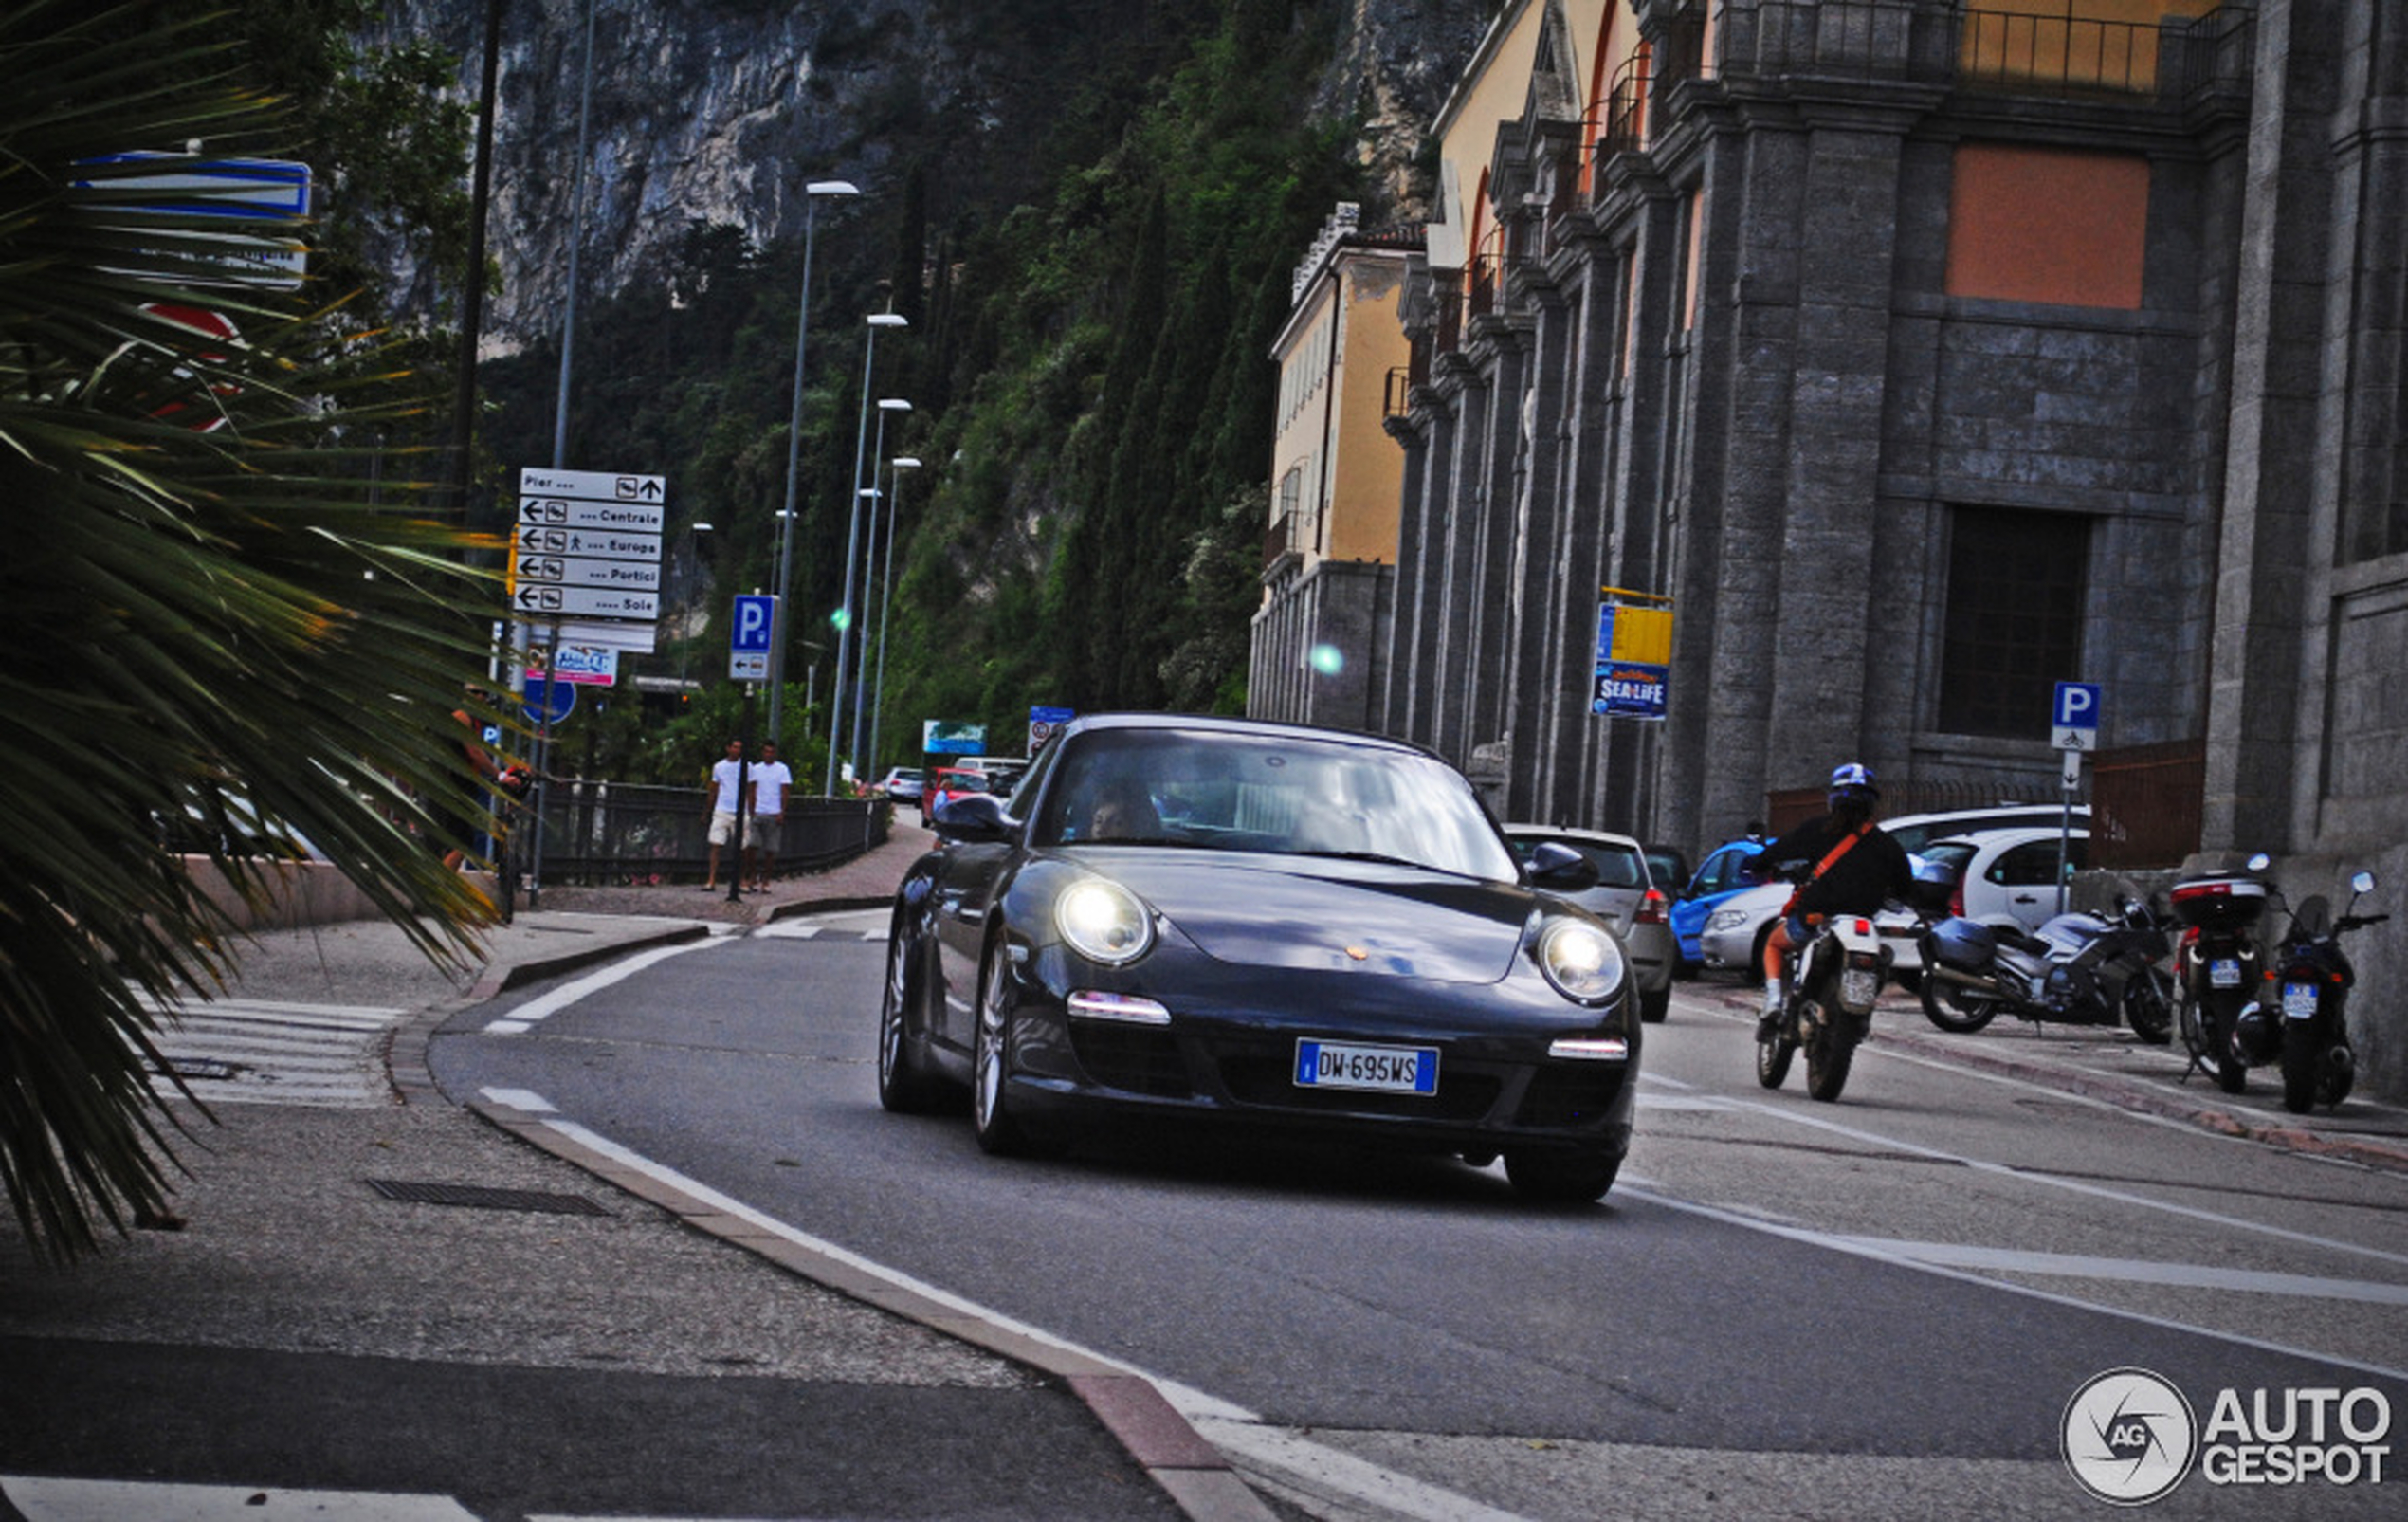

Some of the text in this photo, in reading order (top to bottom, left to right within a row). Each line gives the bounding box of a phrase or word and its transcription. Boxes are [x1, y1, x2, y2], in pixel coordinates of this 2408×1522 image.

[524, 475, 553, 488] Pier
[600, 510, 659, 524] Centrale
[610, 540, 656, 554] Europa
[611, 569, 656, 582] Portici
[623, 598, 653, 611] Sole
[1600, 679, 1632, 700] SEA
[2062, 687, 2091, 723] P
